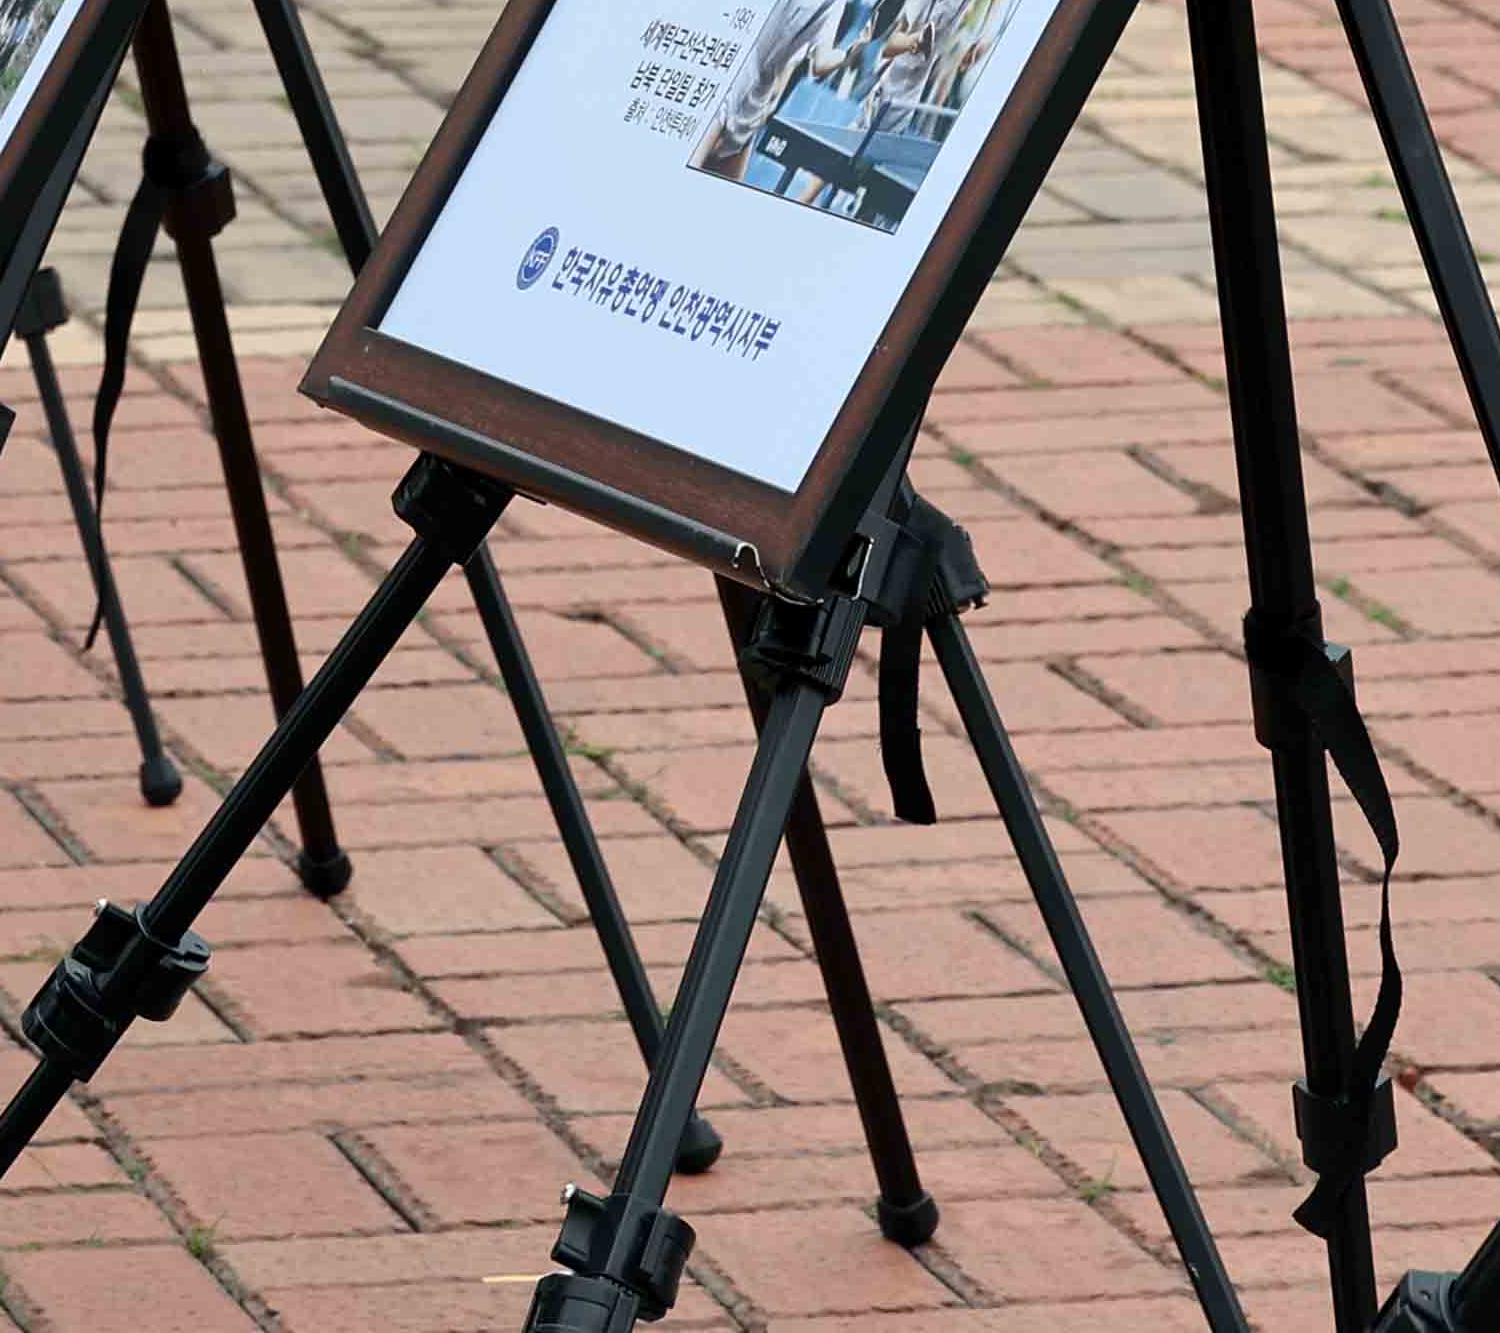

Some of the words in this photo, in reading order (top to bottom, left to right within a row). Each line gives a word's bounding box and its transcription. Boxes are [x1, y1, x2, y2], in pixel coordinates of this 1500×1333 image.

[640, 21, 742, 73] 세계탁구선수권대회
[630, 61, 662, 92] 남북
[654, 69, 696, 104] 단일팀
[688, 77, 720, 111] 참가
[552, 247, 670, 323] 한국자유총연맹
[658, 285, 781, 361] 인천광역시지부
